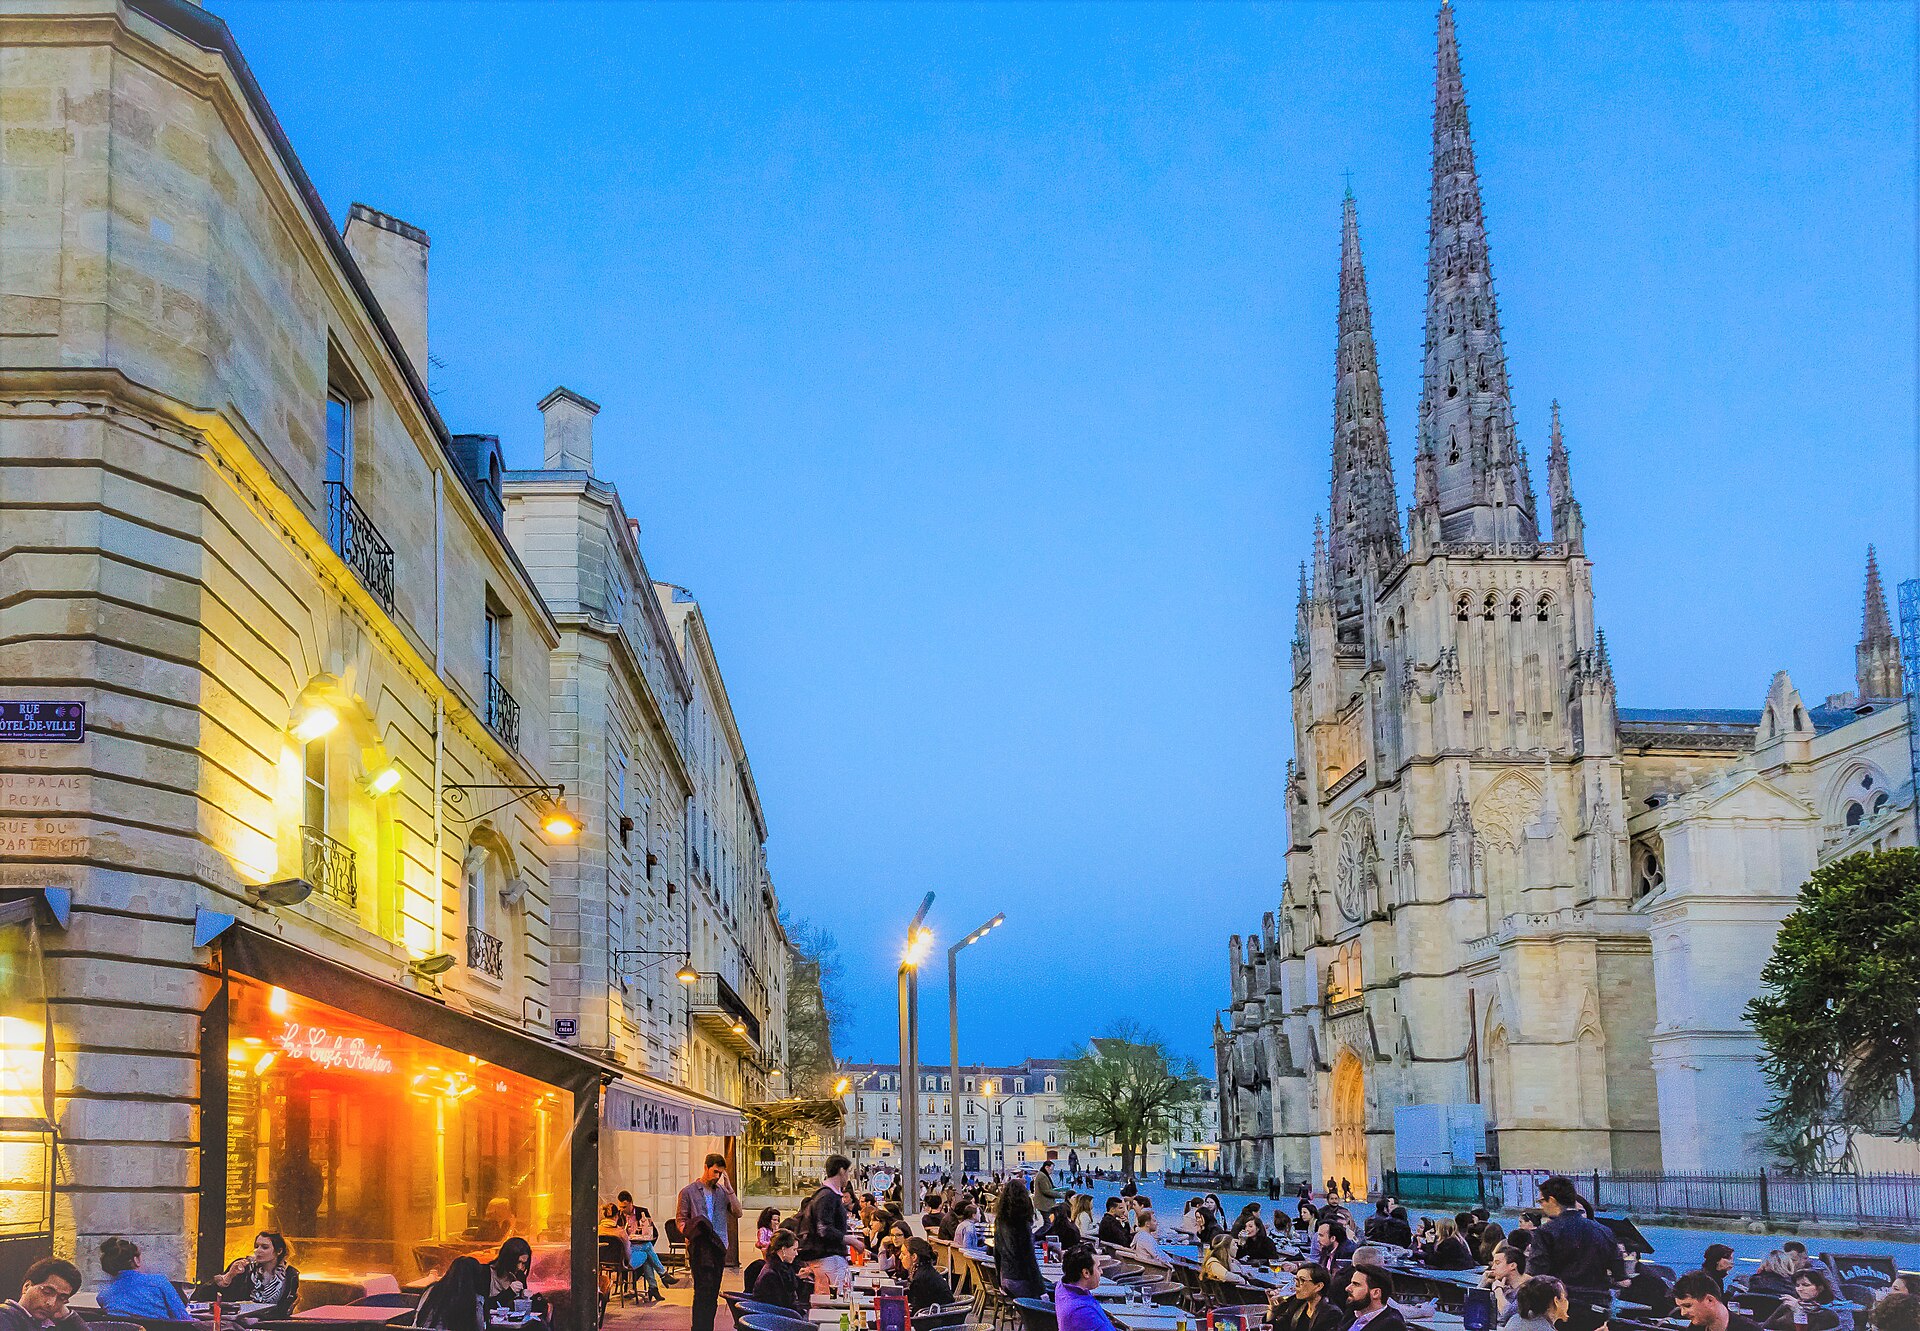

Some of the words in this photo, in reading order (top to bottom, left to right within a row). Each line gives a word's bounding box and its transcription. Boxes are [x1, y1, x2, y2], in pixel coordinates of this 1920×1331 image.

[19, 704, 40, 714] RUE
[24, 713, 35, 721] DE
[17, 748, 48, 759] RUE
[28, 777, 80, 789] PALAIS
[9, 794, 62, 806] ROYAL
[0, 822, 28, 834] RUE
[46, 822, 67, 834] DU
[630, 1100, 641, 1128] Le
[643, 1103, 659, 1131] Café
[661, 1107, 679, 1132] Rohan
[1840, 1270, 1854, 1280] Le
[1852, 1265, 1891, 1282] Rohan
